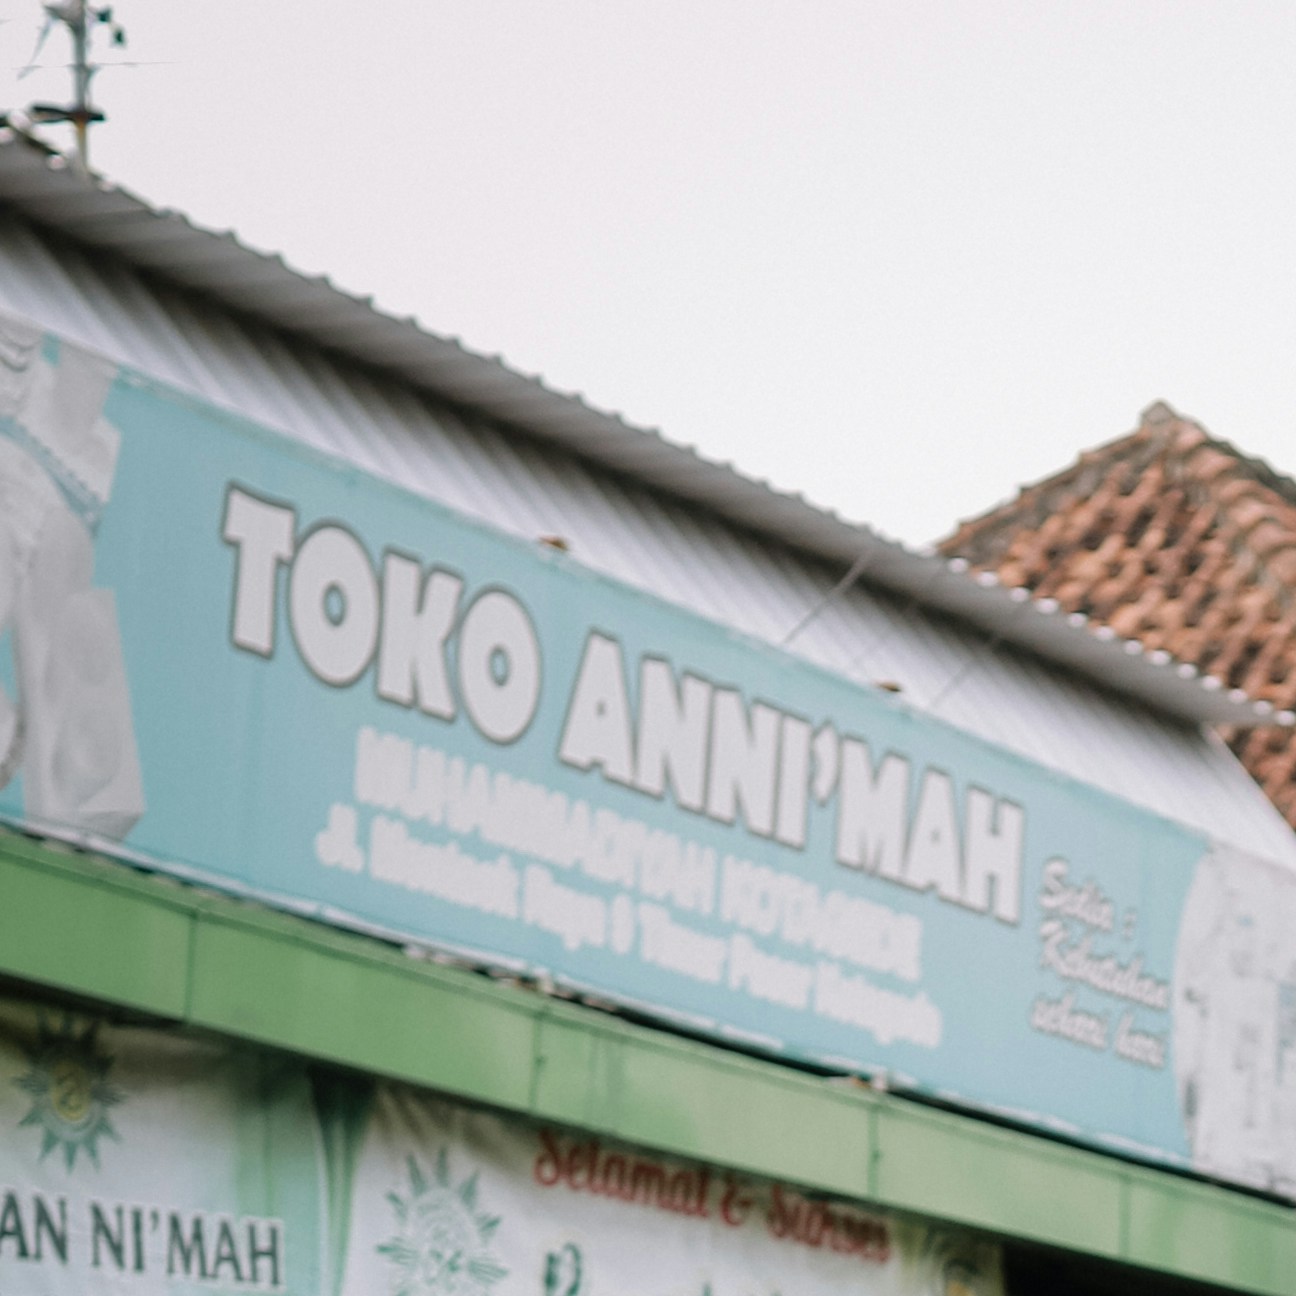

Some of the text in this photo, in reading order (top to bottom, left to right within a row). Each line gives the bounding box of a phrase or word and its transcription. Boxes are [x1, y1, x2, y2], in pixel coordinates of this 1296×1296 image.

[223, 482, 542, 746] TOKO
[559, 628, 1025, 926] ANNI'MAH
[0, 1191, 282, 1288] AN NI'MAH
